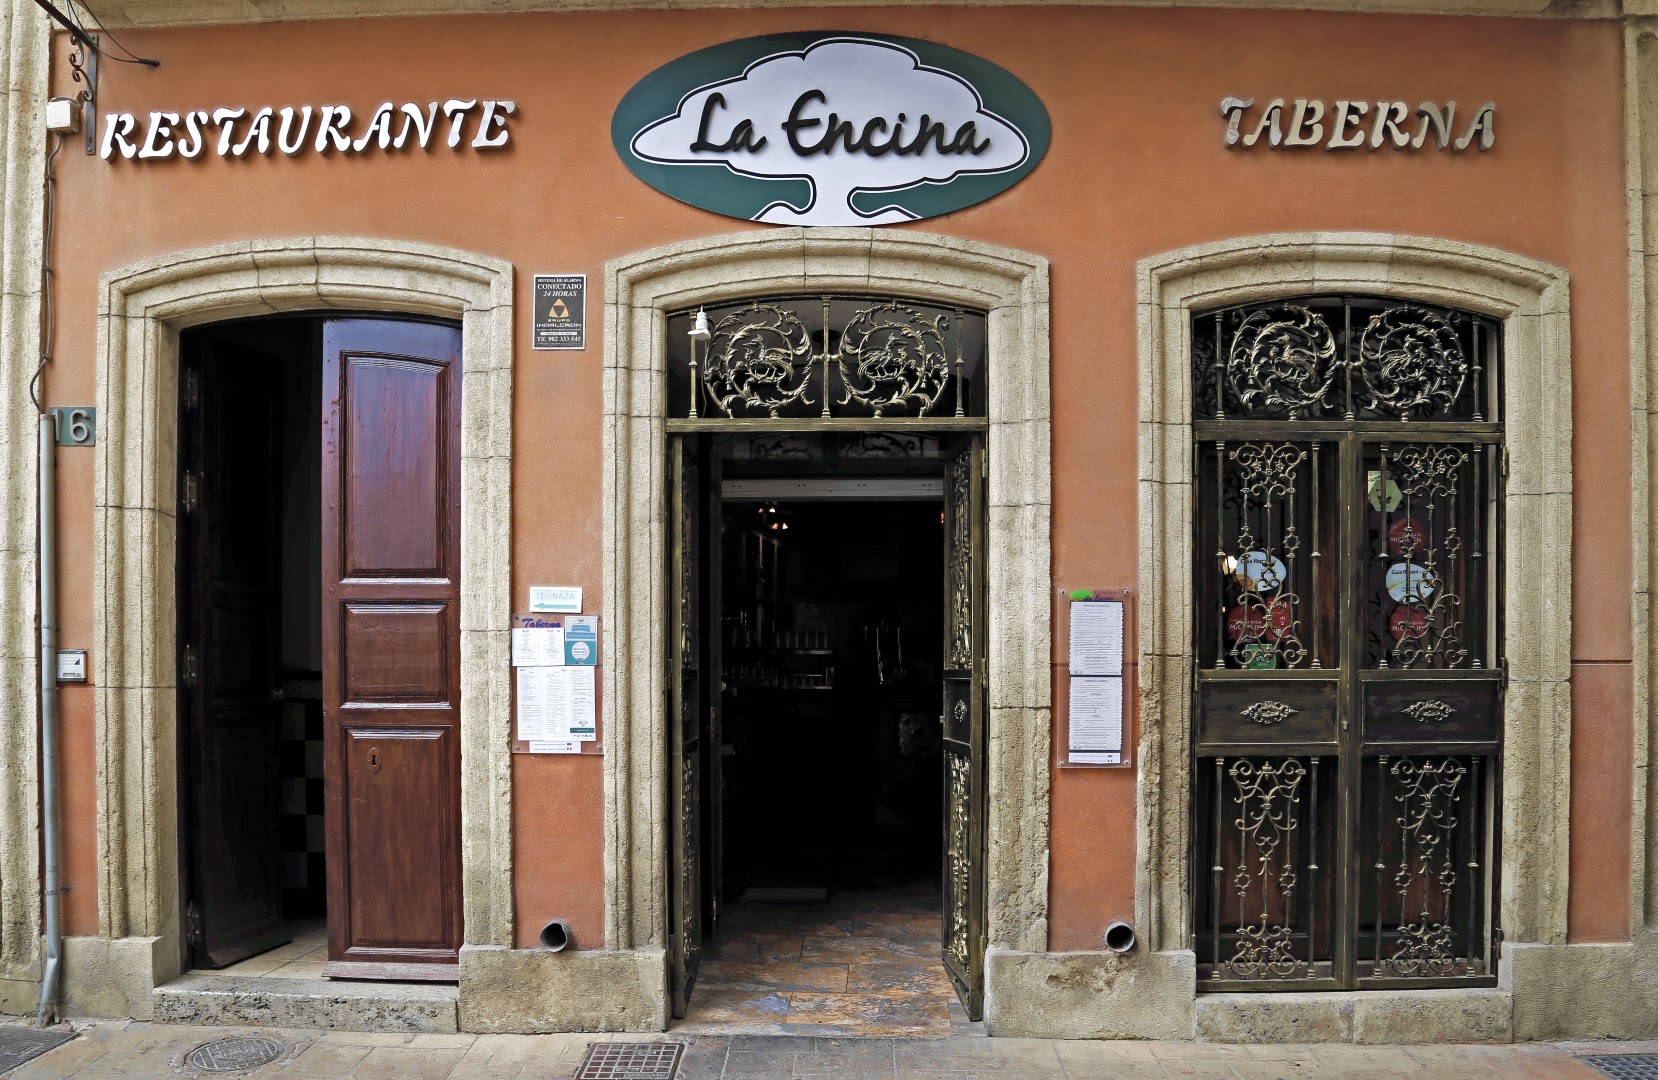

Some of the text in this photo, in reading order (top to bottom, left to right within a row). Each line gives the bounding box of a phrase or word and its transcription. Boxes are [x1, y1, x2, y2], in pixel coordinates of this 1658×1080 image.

[100, 98, 518, 162] RESTAURANTE
[690, 88, 991, 157] La Encina
[1219, 96, 1496, 151] TABERNA
[522, 618, 561, 628] Taberna
